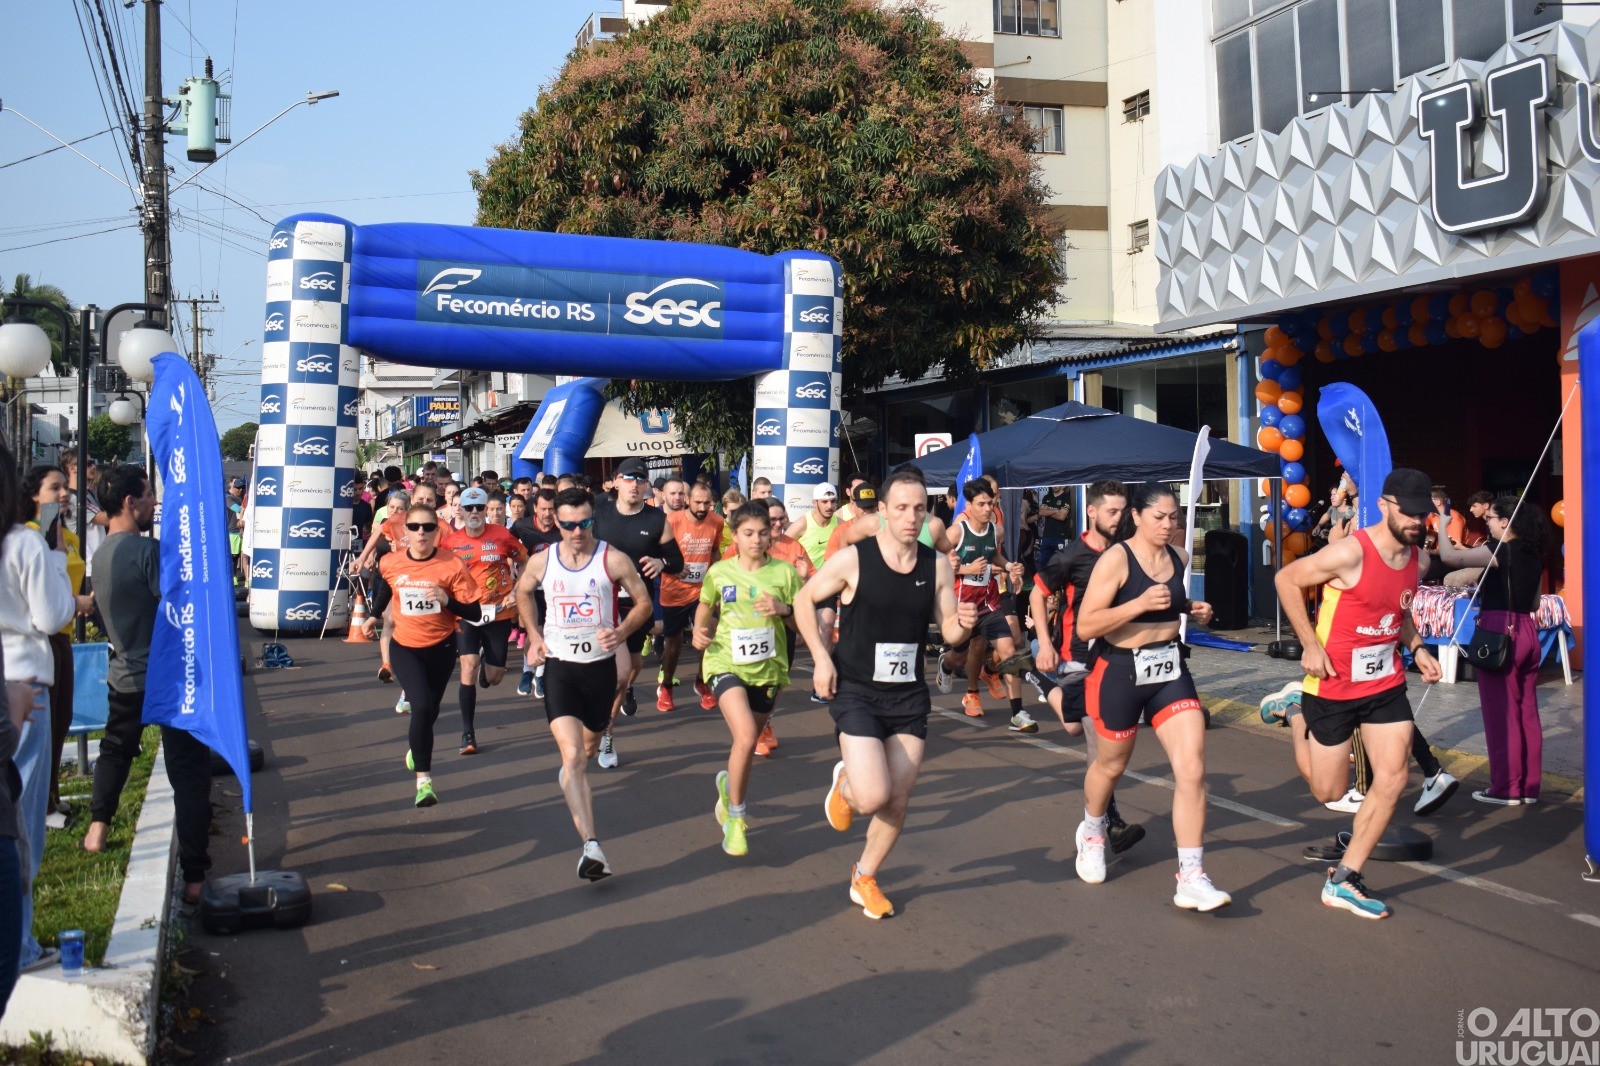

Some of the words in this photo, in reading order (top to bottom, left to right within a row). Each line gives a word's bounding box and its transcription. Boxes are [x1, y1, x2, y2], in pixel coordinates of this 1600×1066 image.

[299, 275, 336, 291] Sesc
[437, 293, 561, 320] Fecomércio
[566, 302, 596, 322] RS
[623, 288, 721, 328] Sesc
[799, 309, 830, 324] Sesc
[296, 358, 333, 373] Sesc
[795, 385, 827, 399] Sesc
[293, 441, 330, 456] Sesc
[626, 438, 685, 453] unopa
[792, 461, 824, 475] Sesc
[199, 501, 207, 544] Comércio
[288, 524, 326, 538] Sesc
[179, 503, 193, 582] Sindicatos
[202, 543, 210, 584] Sistema
[406, 600, 434, 611] 145
[559, 601, 594, 618] TAG
[181, 602, 194, 626] RS
[284, 607, 322, 621] Sesc
[482, 614, 490, 624] 0
[569, 641, 592, 655] 70
[738, 641, 770, 656] 125
[181, 626, 195, 715] Fecomércio
[889, 661, 908, 676] 78
[1144, 660, 1174, 678] 179
[1365, 658, 1384, 675] 54
[1115, 727, 1136, 739] RUN
